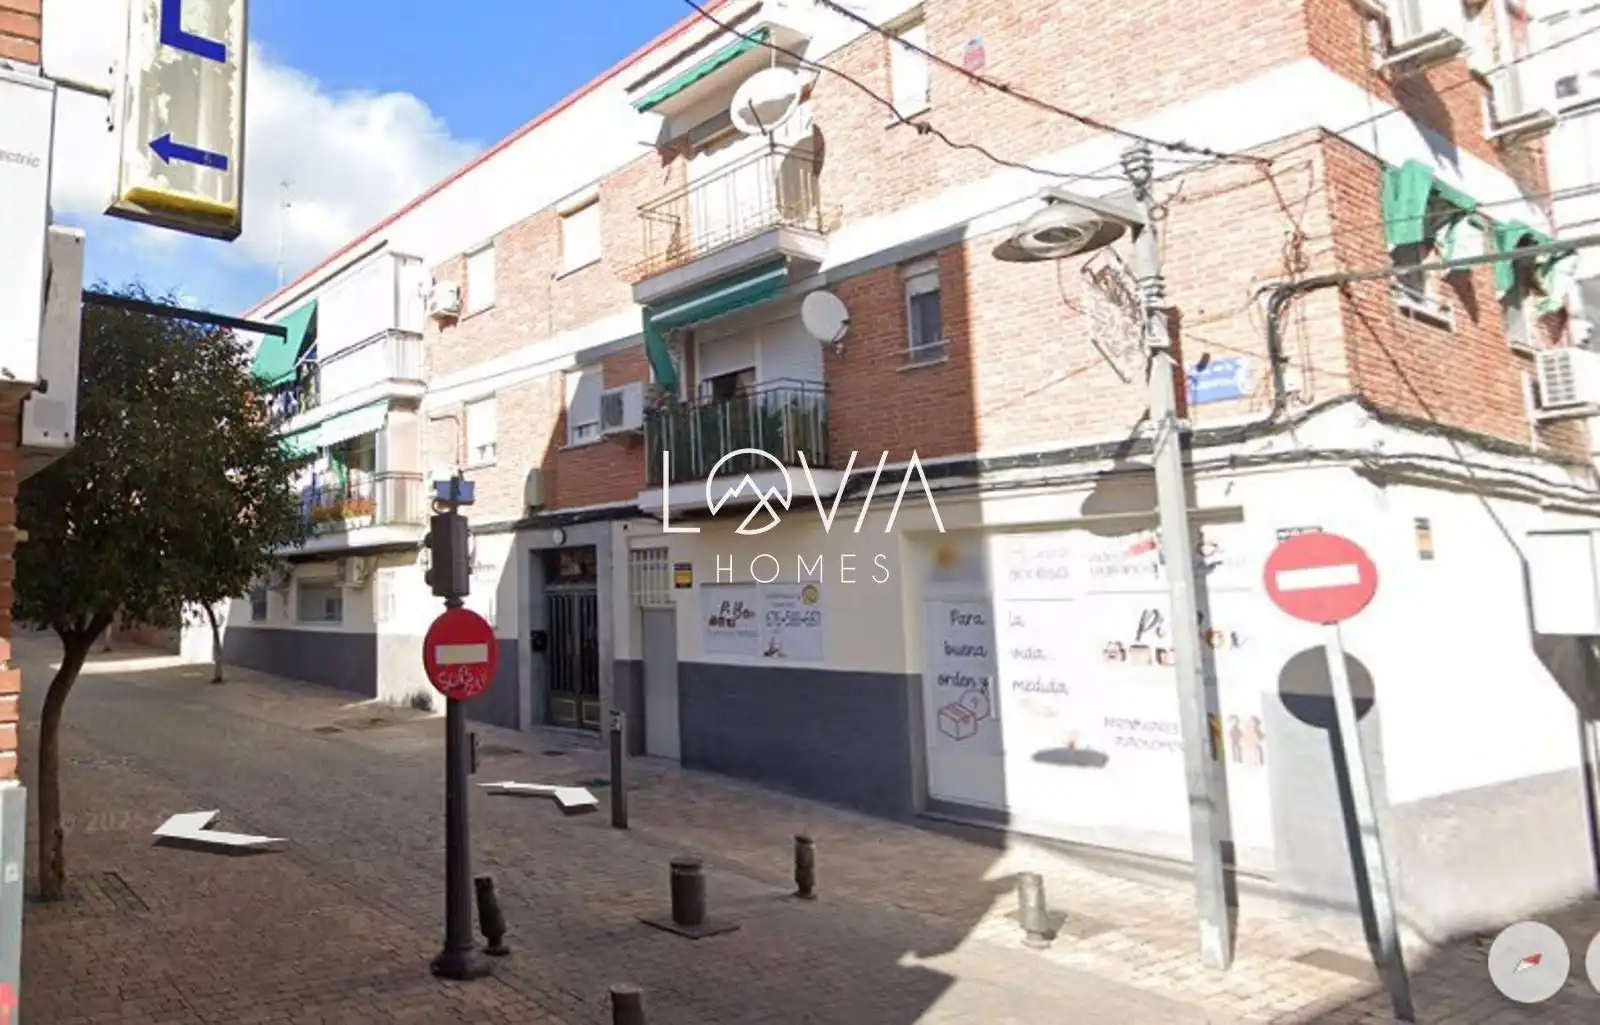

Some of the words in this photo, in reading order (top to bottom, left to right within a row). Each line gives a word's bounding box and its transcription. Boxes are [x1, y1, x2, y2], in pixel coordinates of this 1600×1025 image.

[950, 609, 985, 627] Para
[943, 640, 988, 658] buena
[937, 671, 976, 688] orden
